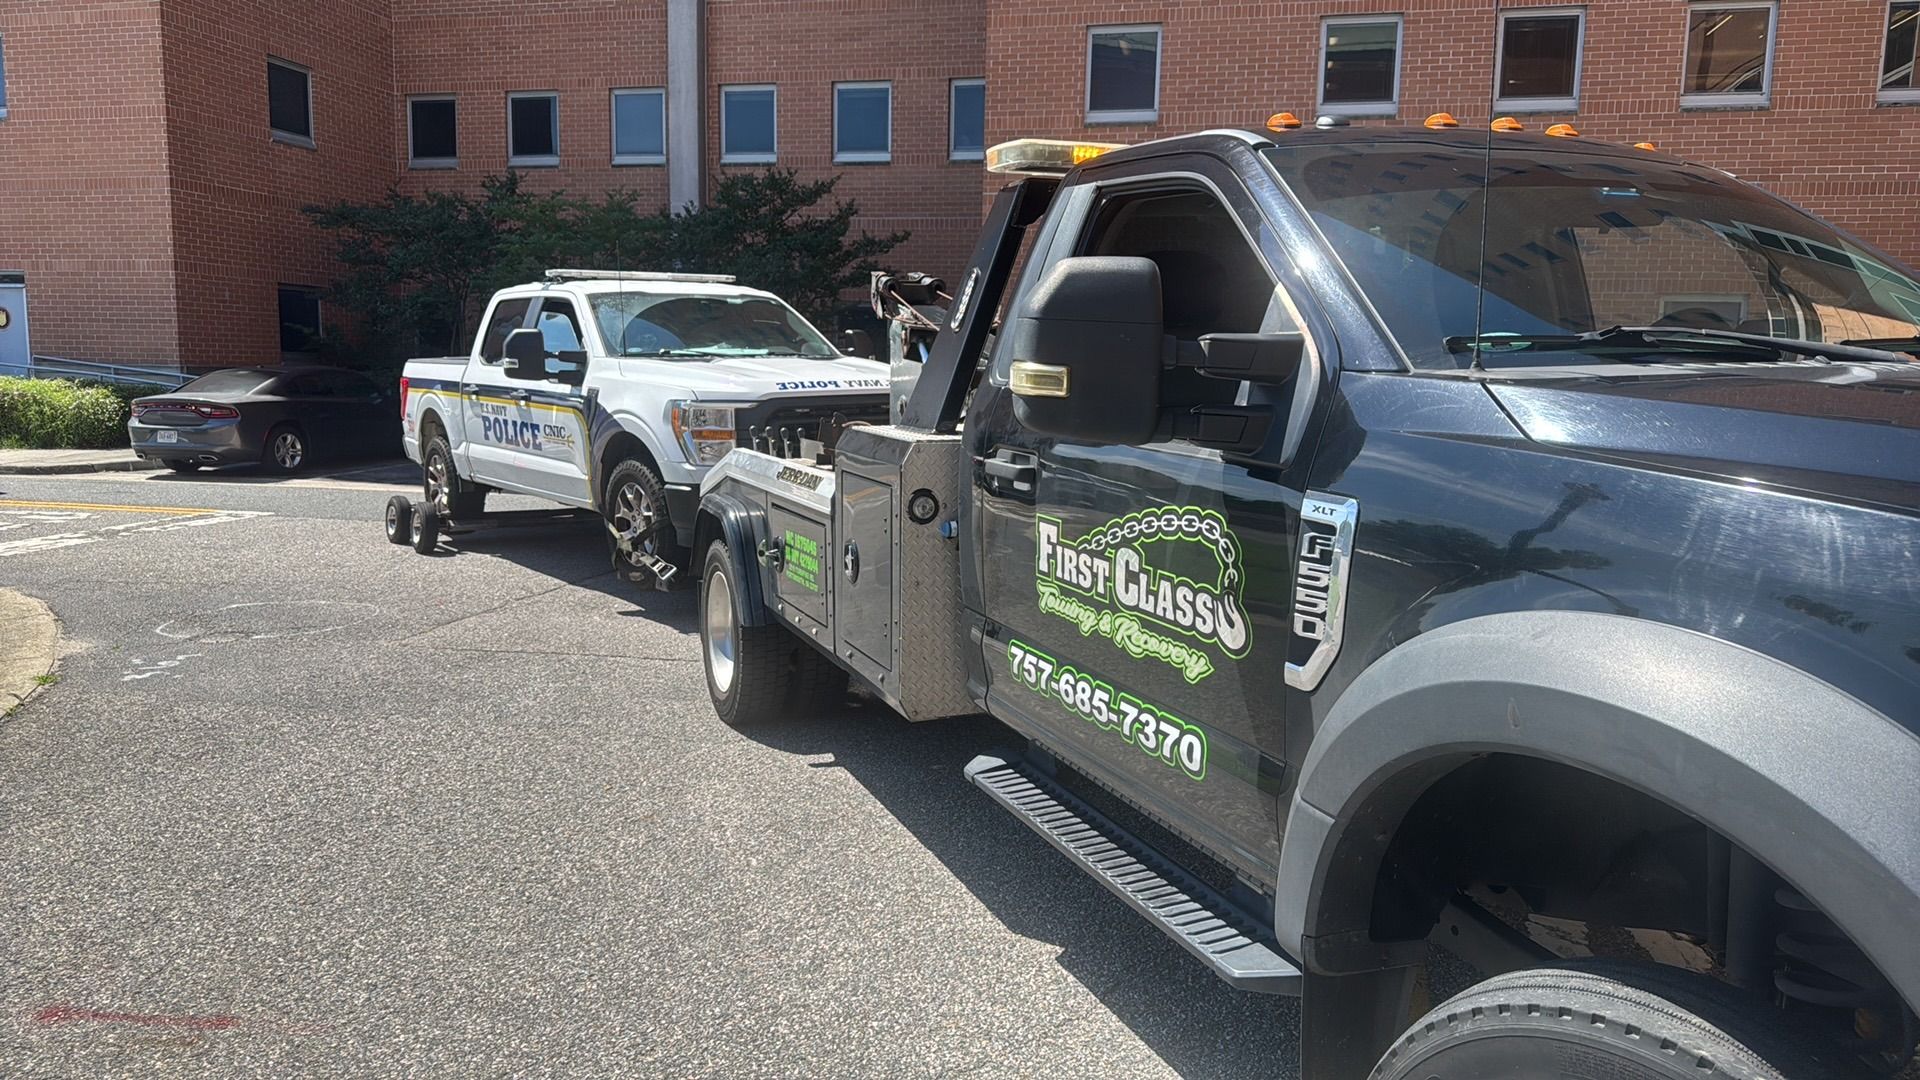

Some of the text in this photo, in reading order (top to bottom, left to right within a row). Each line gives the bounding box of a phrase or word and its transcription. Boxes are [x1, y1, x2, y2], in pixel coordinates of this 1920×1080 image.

[491, 404, 507, 417] NAVY
[481, 415, 543, 451] POLICE
[543, 424, 566, 439] CNIC
[1312, 504, 1337, 517] XLT
[1038, 521, 1214, 634] FIRST CLASS
[1037, 581, 1211, 681] Towing & Recovery
[1010, 645, 1202, 772] 757-685-7370
